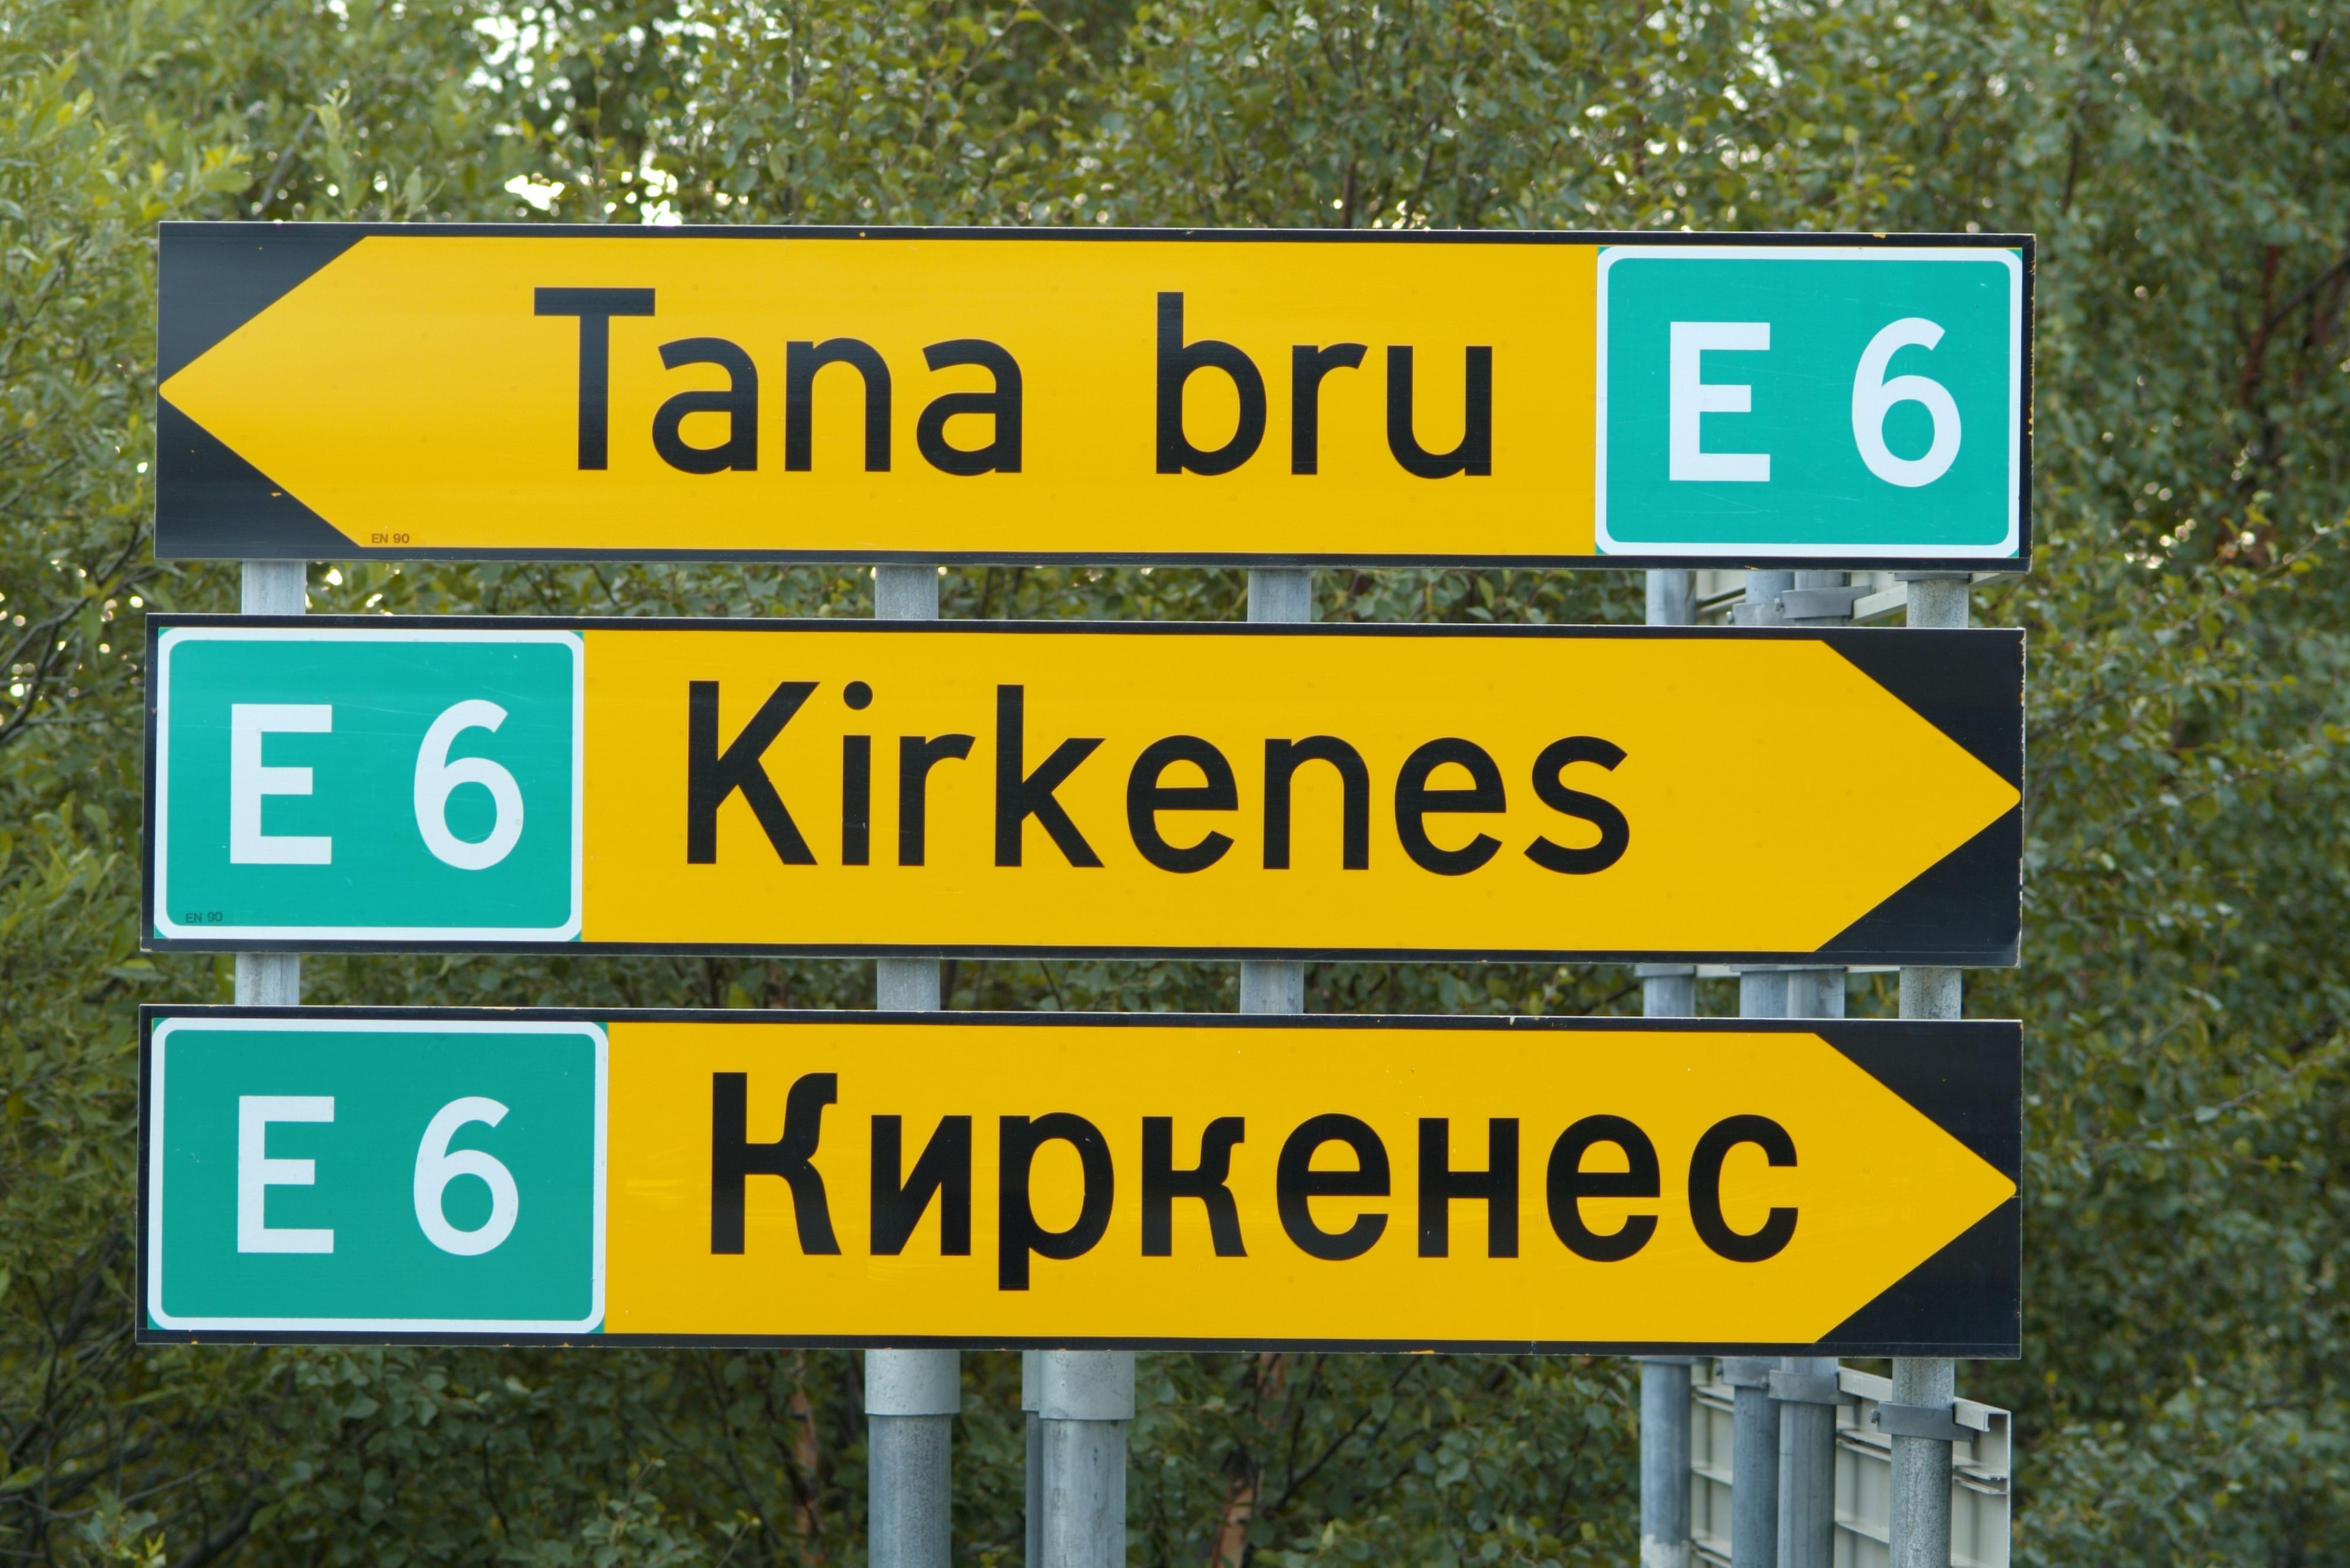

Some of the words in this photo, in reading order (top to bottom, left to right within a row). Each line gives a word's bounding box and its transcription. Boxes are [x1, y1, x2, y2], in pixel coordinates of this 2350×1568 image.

[535, 288, 1022, 476] Tana
[1157, 293, 1492, 478] bru
[1670, 322, 1770, 481] E
[1852, 318, 1961, 487] 6
[371, 533, 388, 543] EN
[392, 533, 410, 543] 90
[230, 704, 332, 864] E
[414, 700, 523, 869] 6
[687, 681, 1629, 875] Kirkenes
[185, 912, 203, 923] EN
[207, 911, 223, 922] 90
[238, 1096, 334, 1253] E
[414, 1097, 518, 1255] 6
[711, 1073, 1798, 1290] Киркенес
